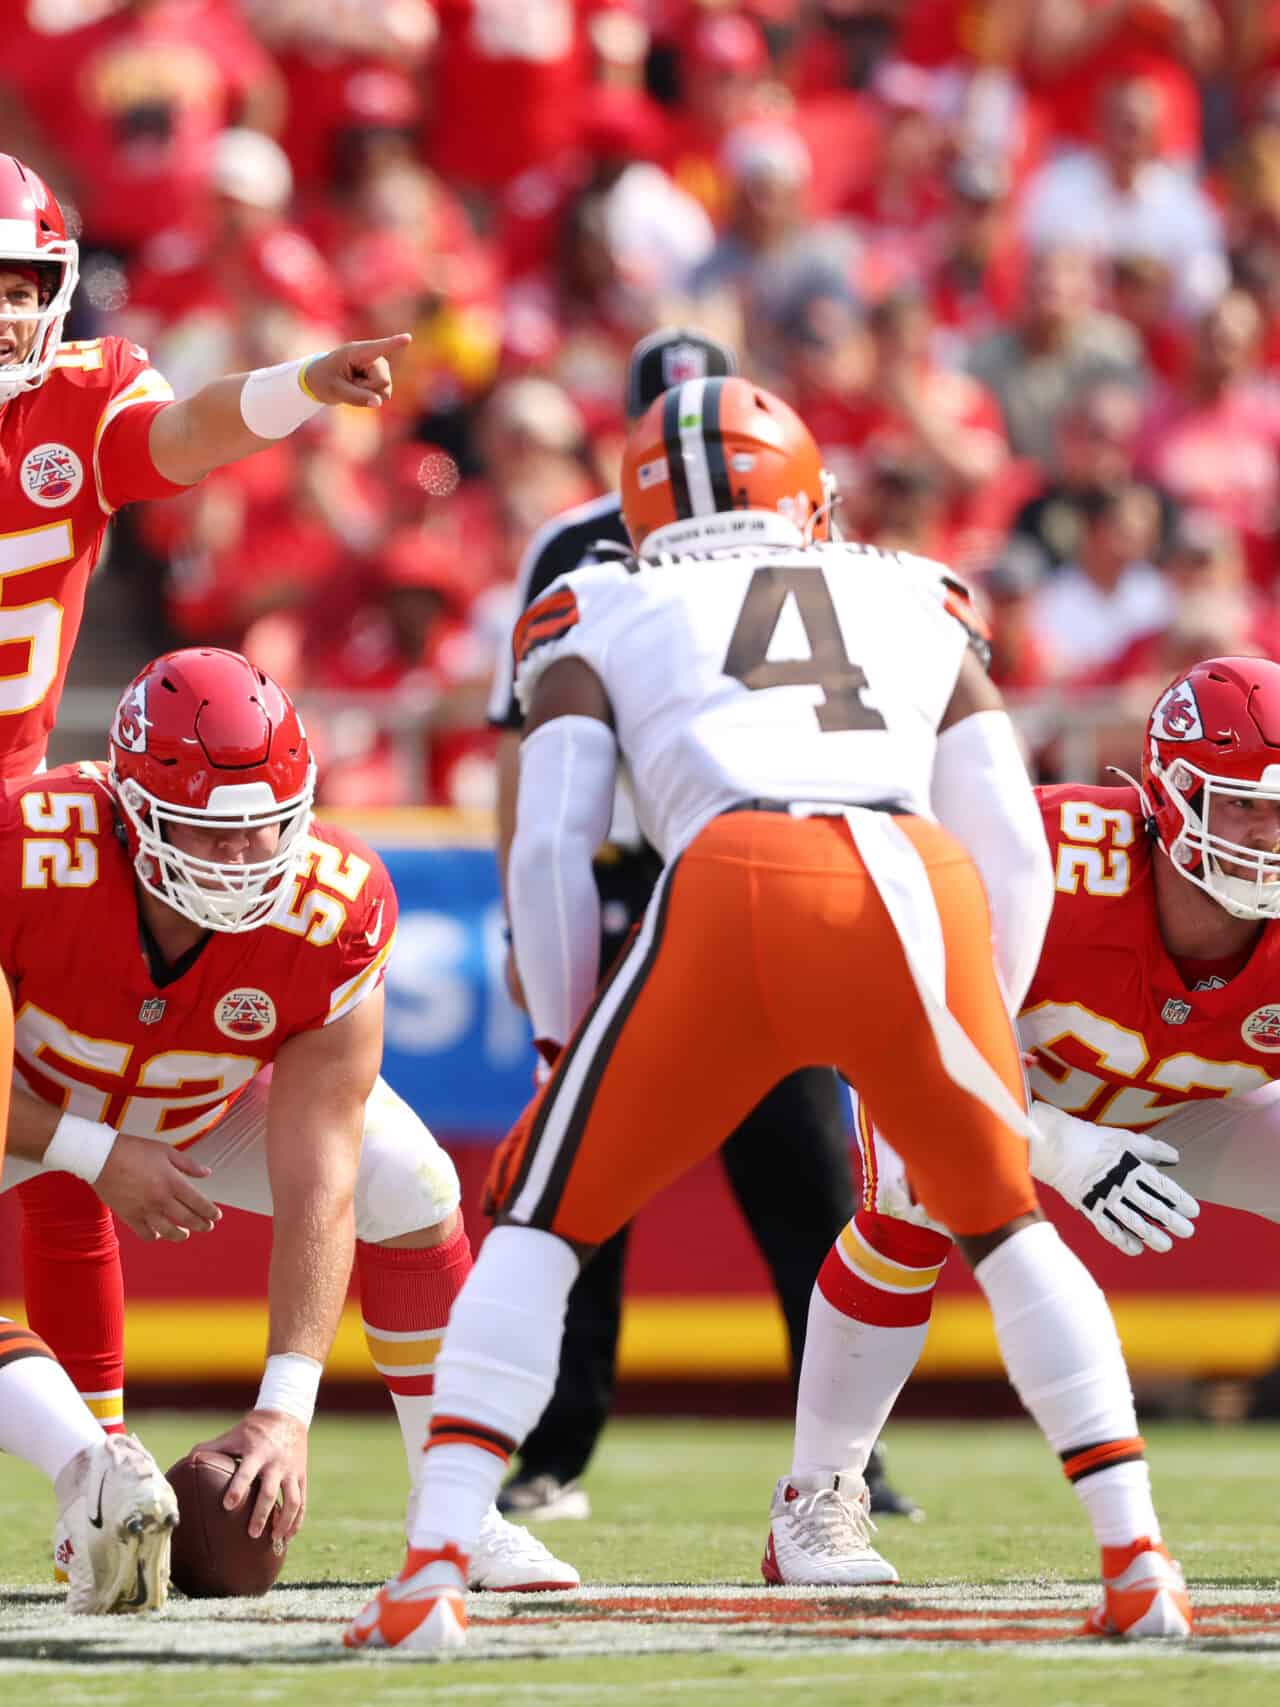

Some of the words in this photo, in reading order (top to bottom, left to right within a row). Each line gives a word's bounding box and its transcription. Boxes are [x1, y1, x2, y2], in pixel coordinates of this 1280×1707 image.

[722, 565, 889, 733] 4
[20, 790, 100, 890] 52
[266, 833, 372, 948] 52
[1055, 800, 1136, 898] 62
[15, 1000, 262, 1147] 52
